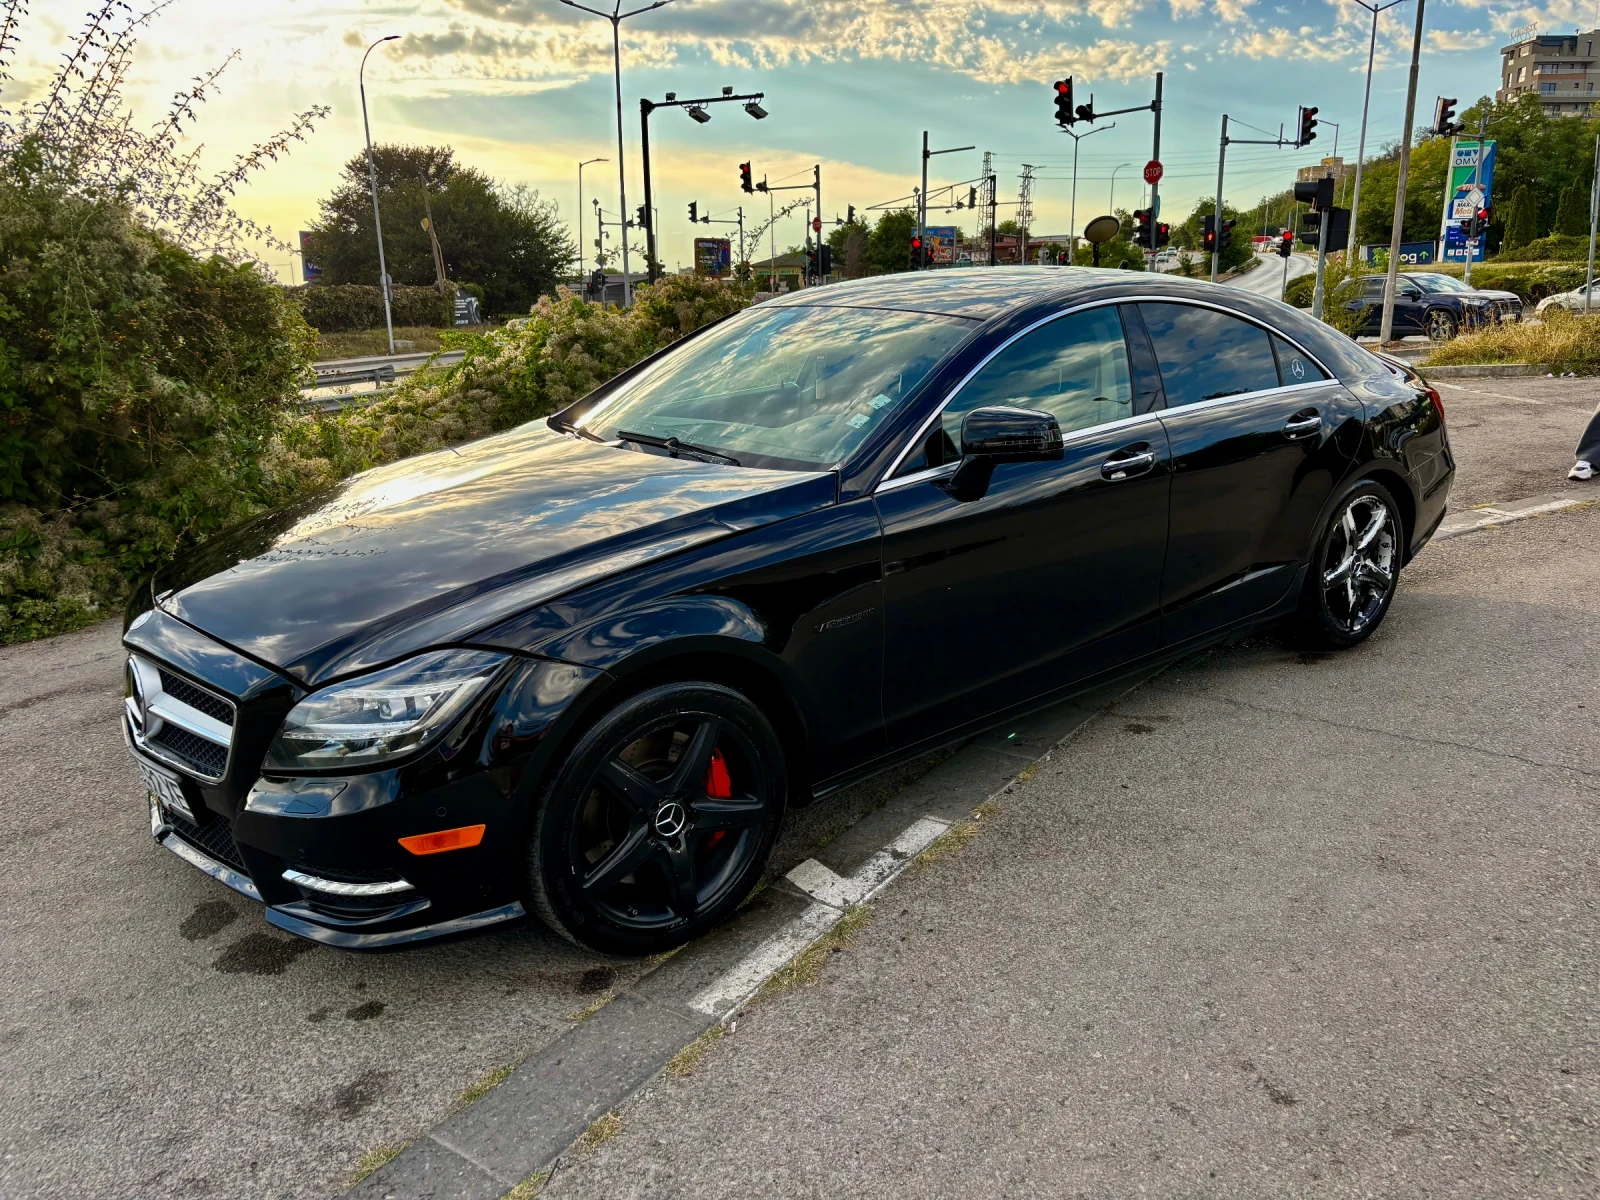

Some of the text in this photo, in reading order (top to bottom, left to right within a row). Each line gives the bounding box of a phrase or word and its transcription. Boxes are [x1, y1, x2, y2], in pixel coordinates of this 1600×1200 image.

[1455, 157, 1478, 166] OMV
[1145, 166, 1161, 178] STOP
[1454, 208, 1473, 216] Moti
[1399, 252, 1417, 264] og
